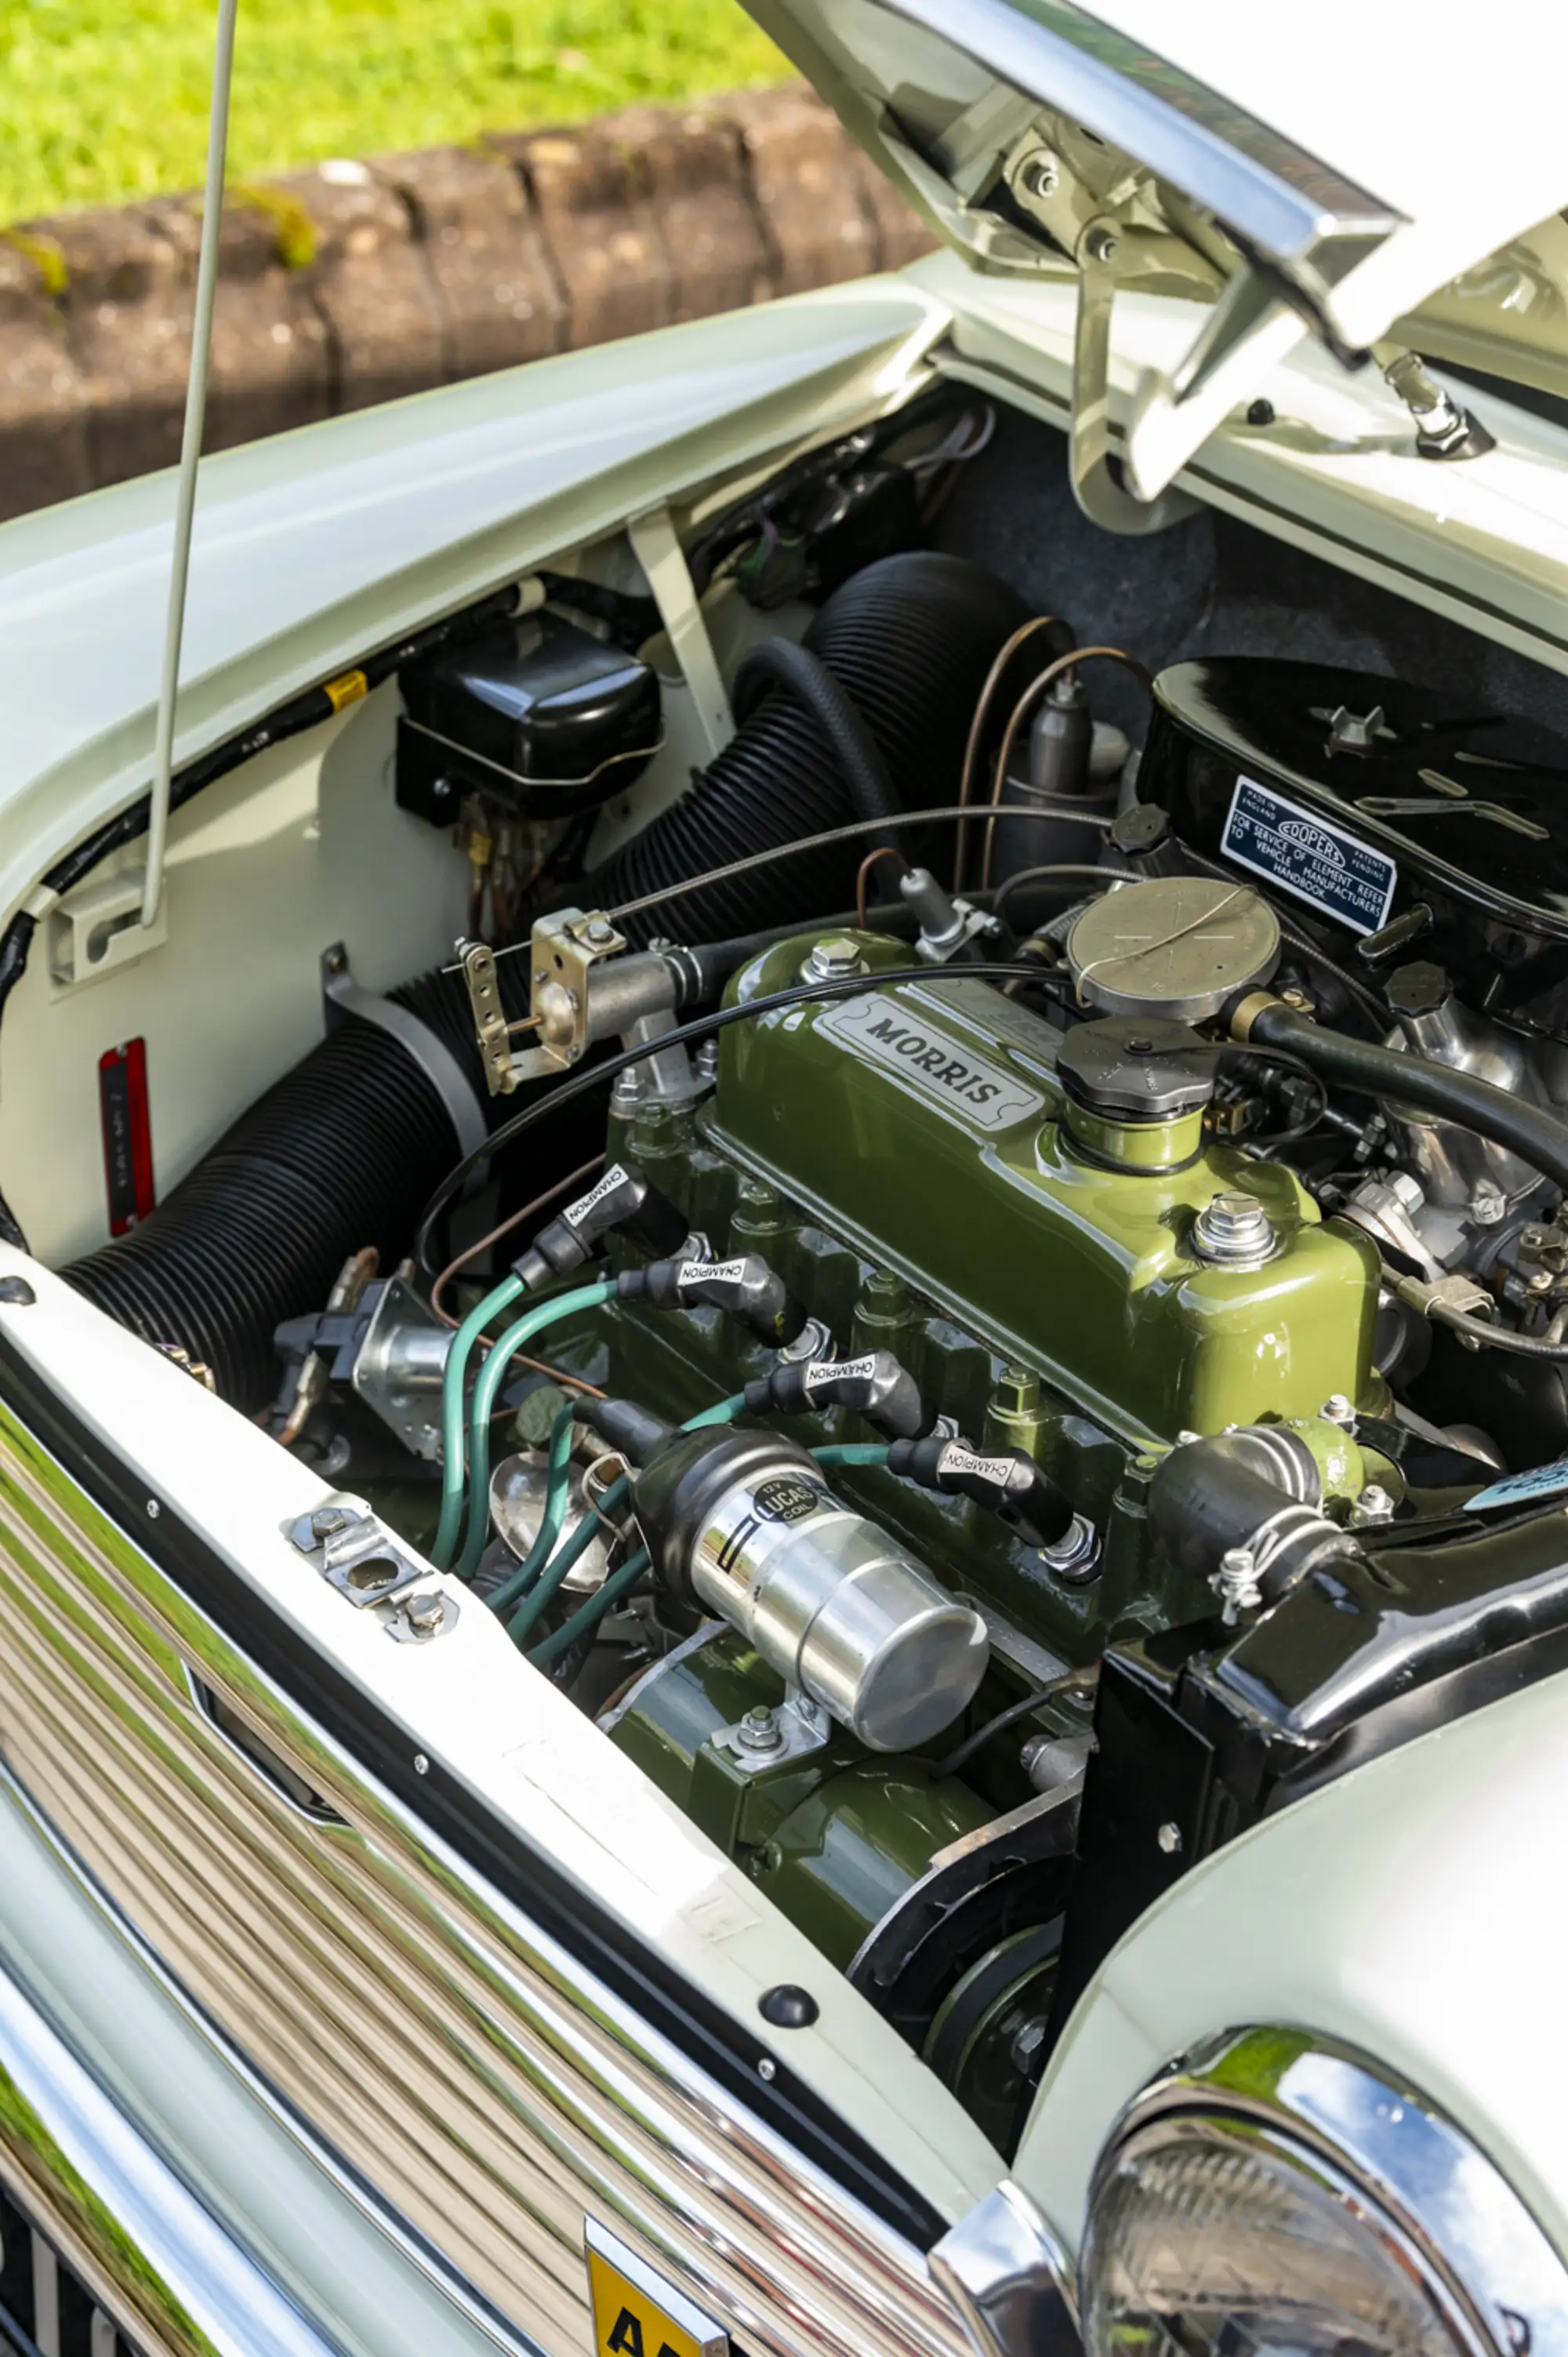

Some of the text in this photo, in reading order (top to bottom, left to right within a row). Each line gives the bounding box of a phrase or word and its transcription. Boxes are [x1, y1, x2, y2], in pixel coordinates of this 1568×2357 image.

[1242, 797, 1276, 820] ENGLAND
[1281, 823, 1340, 860] COOPERS
[1231, 825, 1381, 918] TO VEHICLE MANUFACTURERS
[1232, 814, 1385, 905] FOR SERVICE OF ELEMENT REFER
[1352, 859, 1385, 881] PENDING
[865, 1018, 1002, 1104] MORRIS
[570, 1169, 622, 1221] CHAMPION
[682, 1264, 742, 1280] CHAMPION
[810, 1360, 873, 1380] CHAMPION
[946, 1452, 1008, 1478] CHAMPION
[763, 1481, 782, 1494] 12V
[757, 1485, 814, 1520] LUCAS
[782, 1502, 813, 1520] COIL
